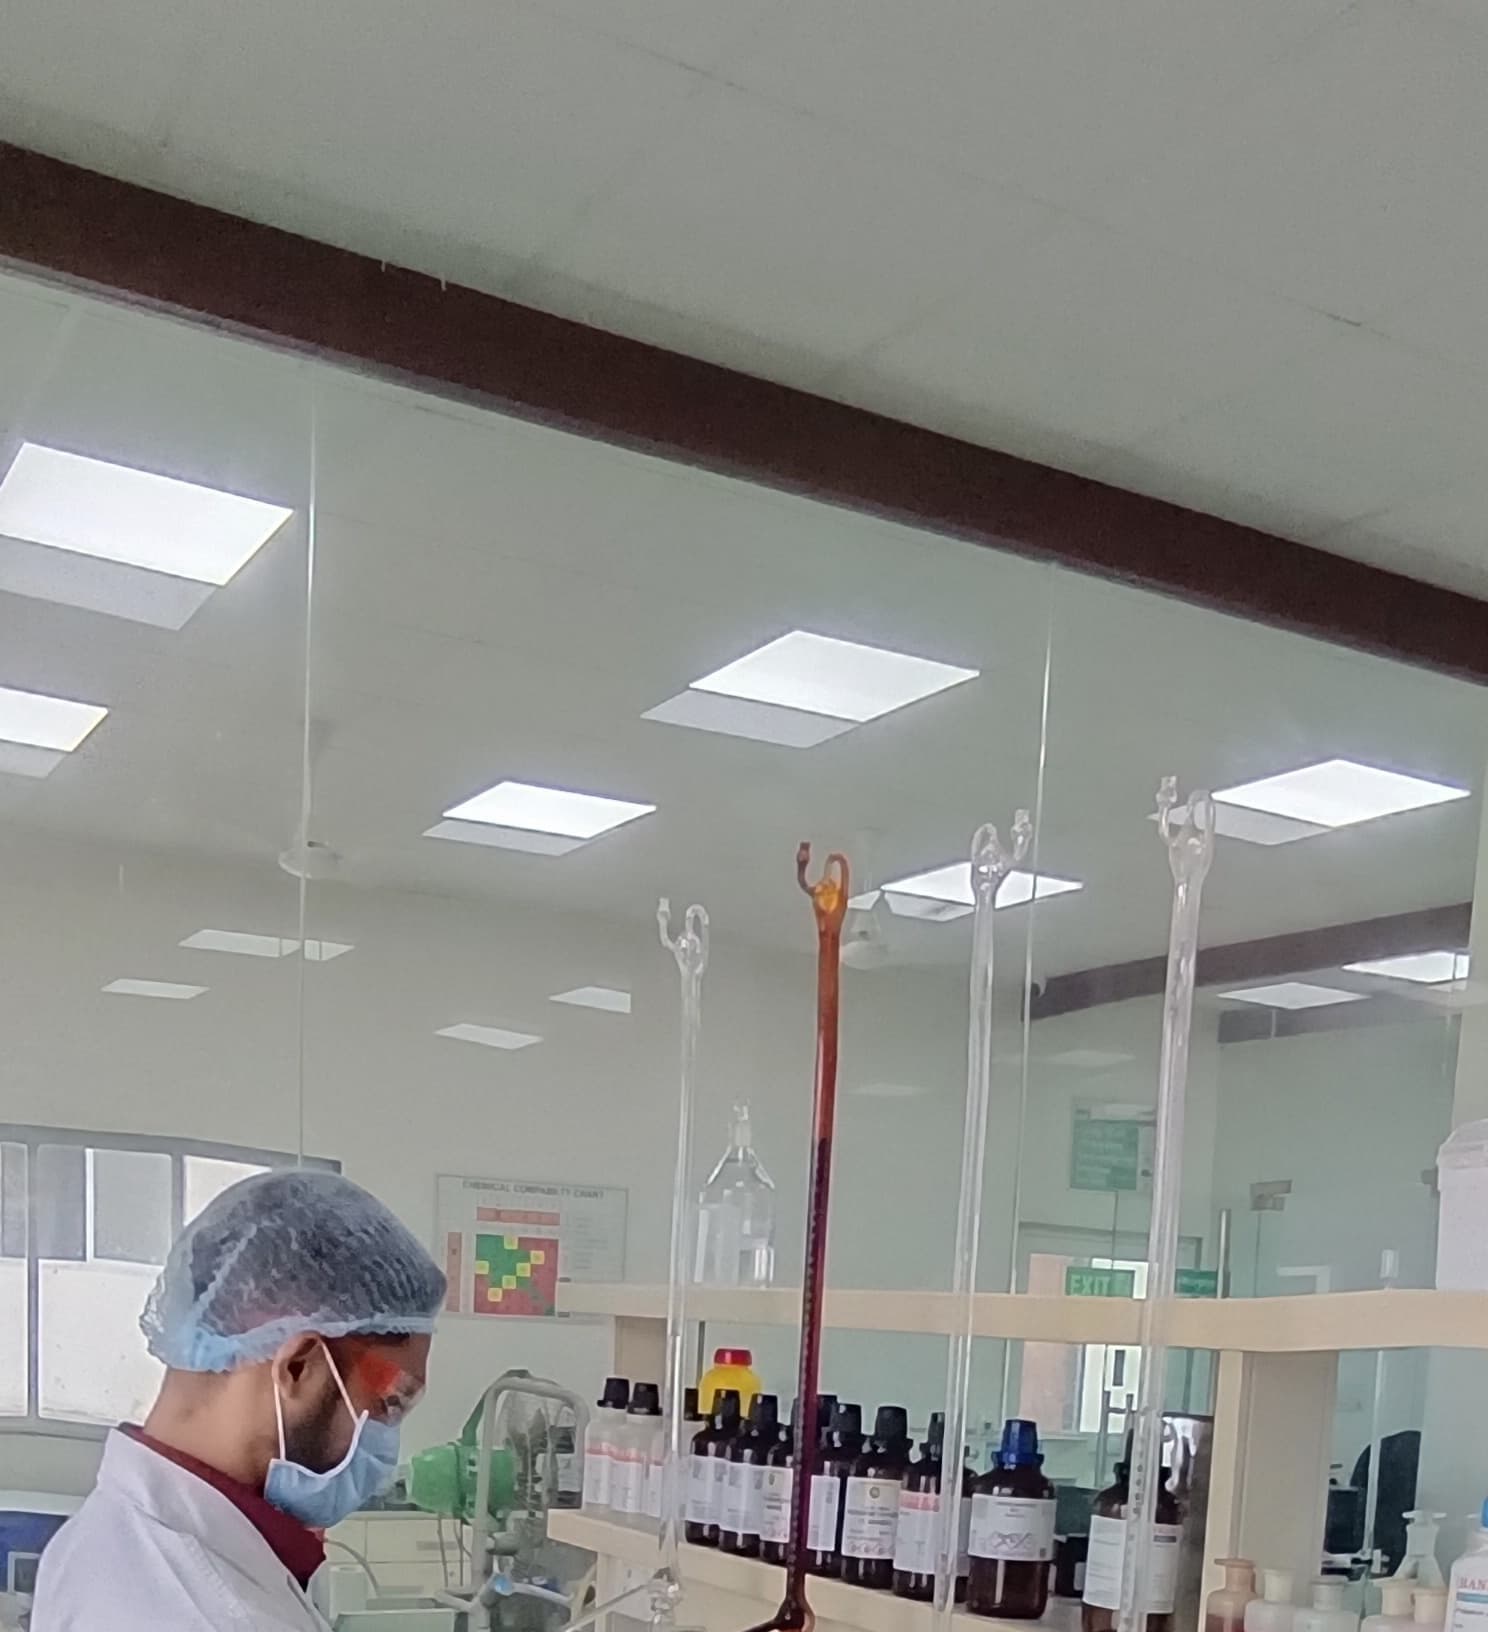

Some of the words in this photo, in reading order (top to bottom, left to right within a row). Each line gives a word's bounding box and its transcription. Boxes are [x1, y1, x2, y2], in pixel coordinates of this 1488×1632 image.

[462, 1179, 511, 1193] CHEMICAL
[573, 1188, 605, 1200] CHART
[1070, 1273, 1111, 1296] EXIT
